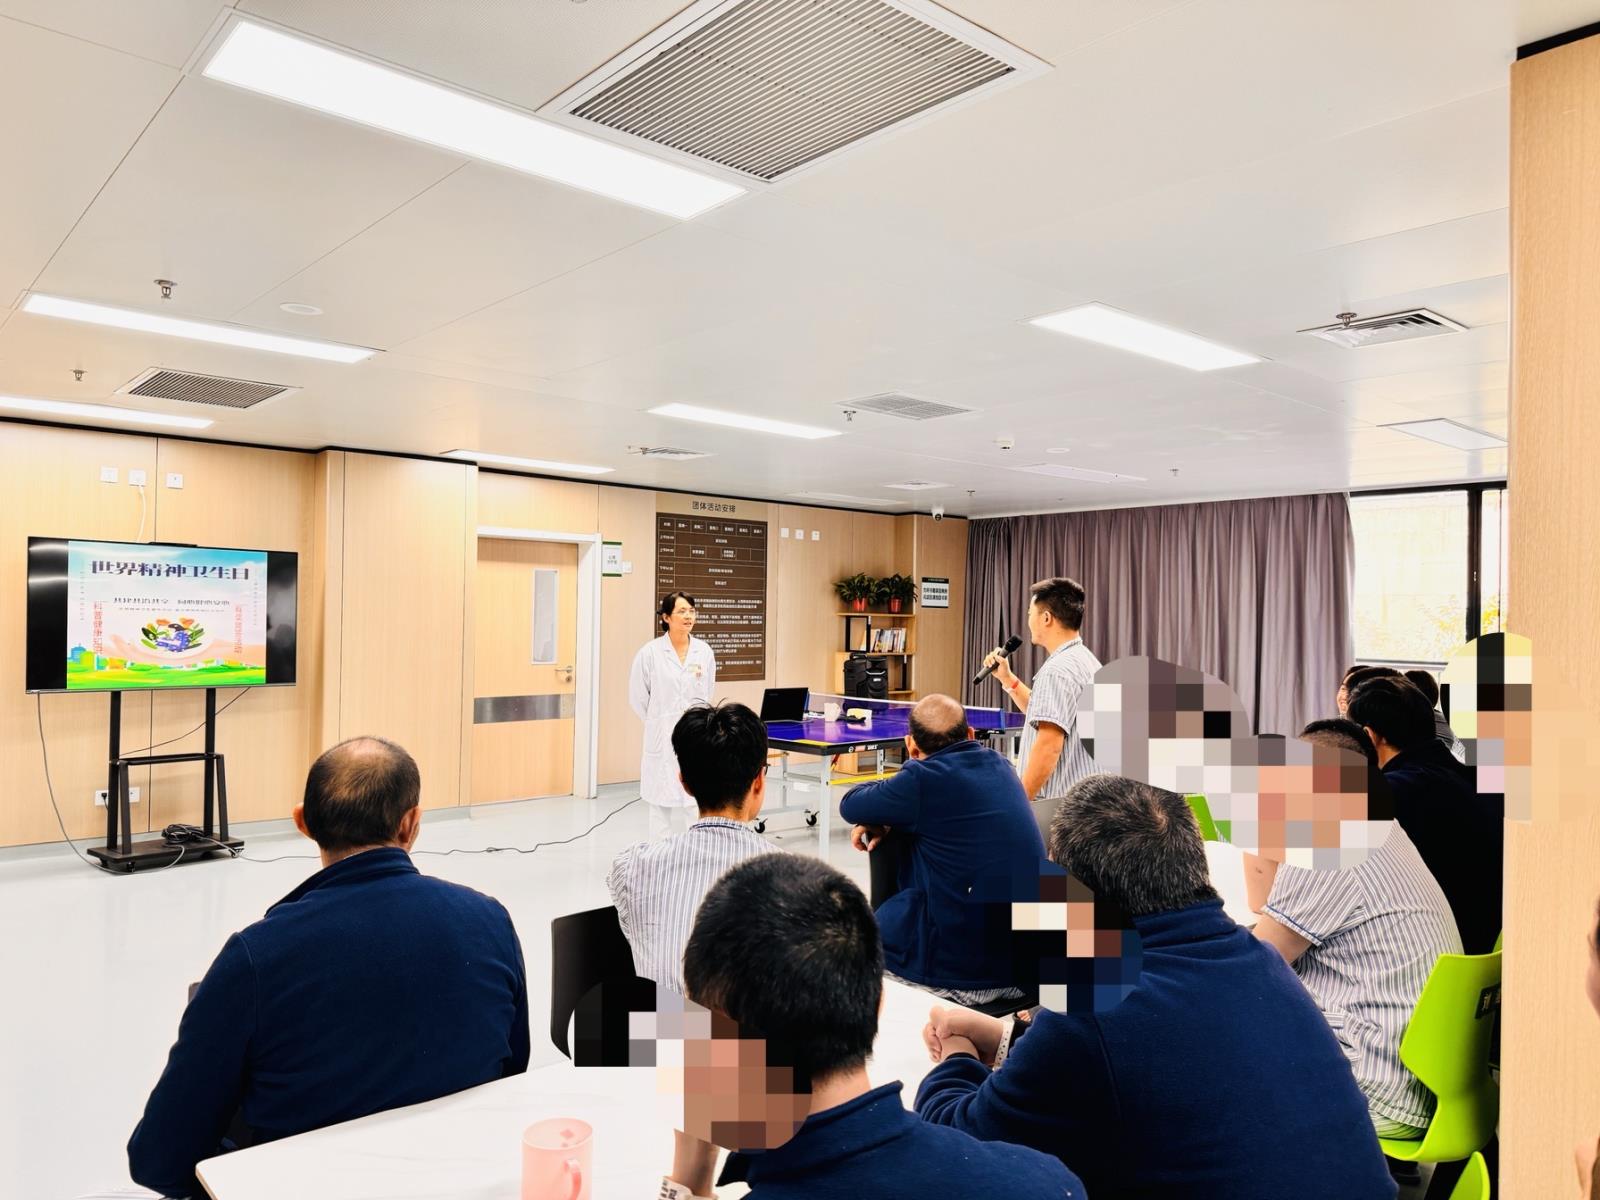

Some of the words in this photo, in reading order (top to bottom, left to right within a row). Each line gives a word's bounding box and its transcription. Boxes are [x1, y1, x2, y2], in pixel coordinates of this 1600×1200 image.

[692, 500, 736, 513] 团体活动安排
[92, 560, 249, 580] 世界精神卫生日
